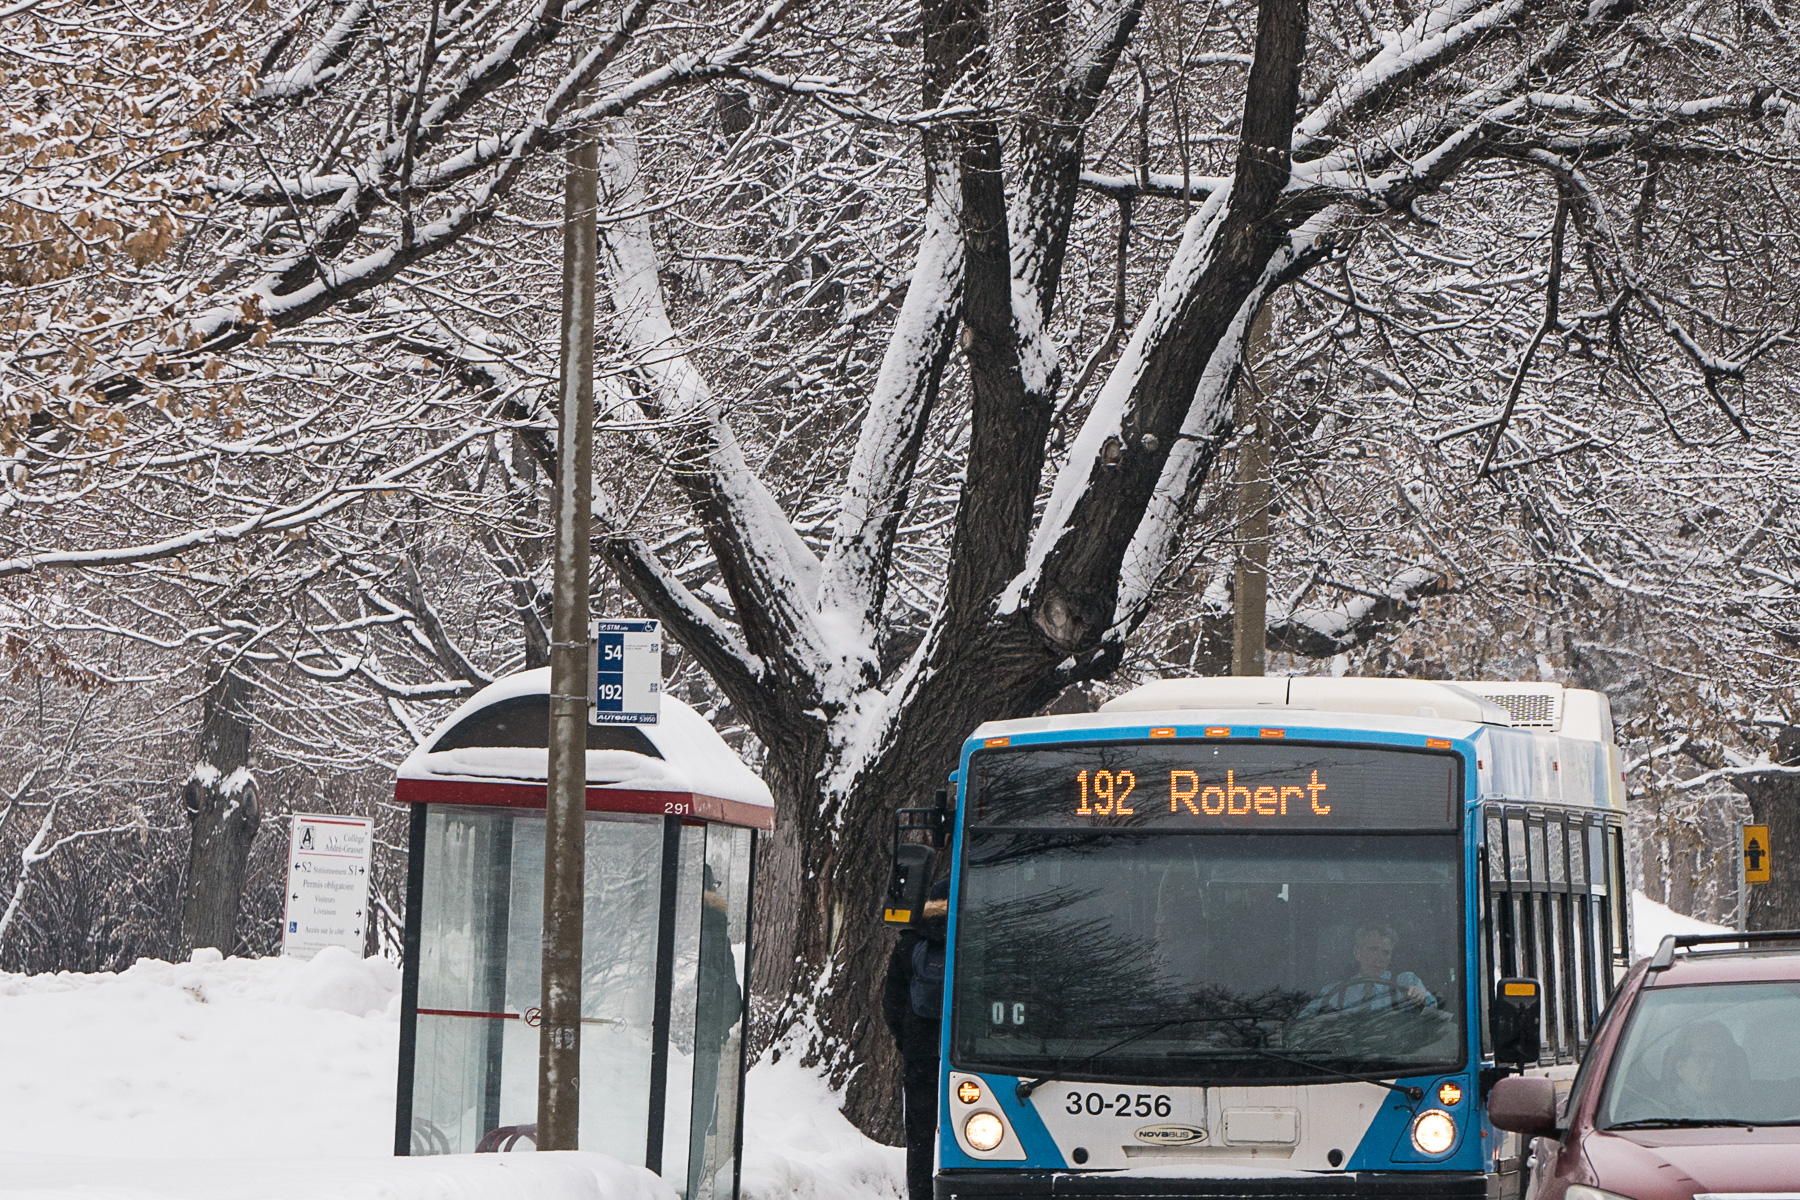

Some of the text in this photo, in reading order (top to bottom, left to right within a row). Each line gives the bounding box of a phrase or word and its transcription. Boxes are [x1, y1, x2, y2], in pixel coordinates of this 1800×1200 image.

[604, 645, 623, 660] 54
[599, 684, 622, 700] 192
[1077, 770, 1331, 815] 192 Robert
[664, 802, 689, 815] 291
[302, 861, 312, 873] S2
[348, 864, 358, 876] S1
[303, 879, 355, 892] Permis obligatoire
[313, 907, 337, 916] Livraison
[1065, 1091, 1172, 1118] 30-256
